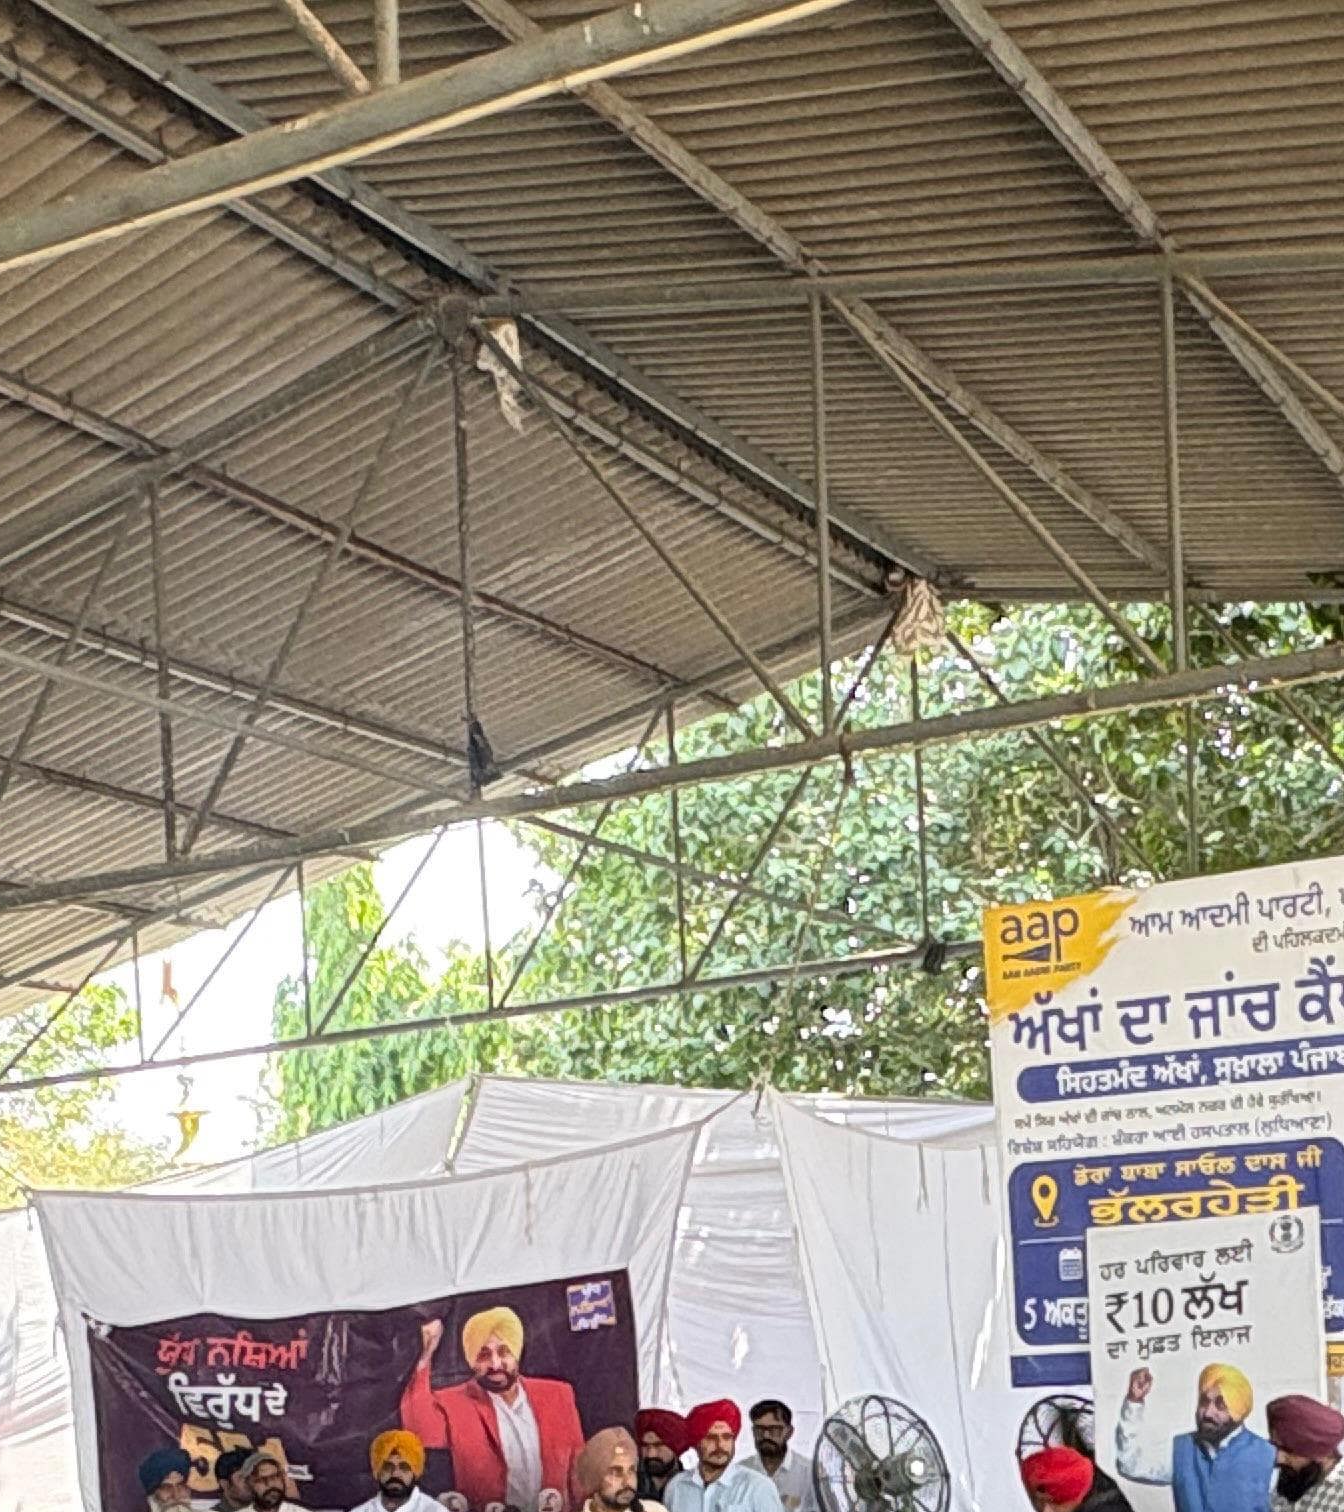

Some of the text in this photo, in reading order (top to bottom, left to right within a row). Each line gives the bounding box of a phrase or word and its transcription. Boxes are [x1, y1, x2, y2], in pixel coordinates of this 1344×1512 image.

[1129, 911, 1173, 937] ਆਮ
[1179, 891, 1250, 931] ਆਦਮੀ
[1256, 881, 1331, 920] ਪਾਰਟੀ,
[1001, 908, 1079, 962] aap
[1253, 930, 1268, 952] ਦੀ
[1008, 988, 1103, 1055] ਅੱਖਾਂ
[1116, 994, 1171, 1045] ਦਾ
[1184, 970, 1280, 1039] ਜਾਂਚ
[1057, 1060, 1147, 1096] ਸਿਹਤਮੰਦ
[1152, 1052, 1207, 1086] ਅੱਖਾਂ,
[1244, 1152, 1288, 1172] ਦਾਸ
[1296, 1144, 1323, 1168] ਜੀ
[1099, 1238, 1254, 1281] ਹਰ ਪਰਿਵਾਰ ਲਈ
[1023, 1297, 1038, 1332] 5
[1105, 1271, 1249, 1334] ₹10 ਲੱਖ
[1106, 1340, 1129, 1360] ਦਾ
[1190, 1324, 1253, 1351] ਇਲਾਜ
[168, 1372, 288, 1430] ਵਿਰੁੱਧ ਦੇ
